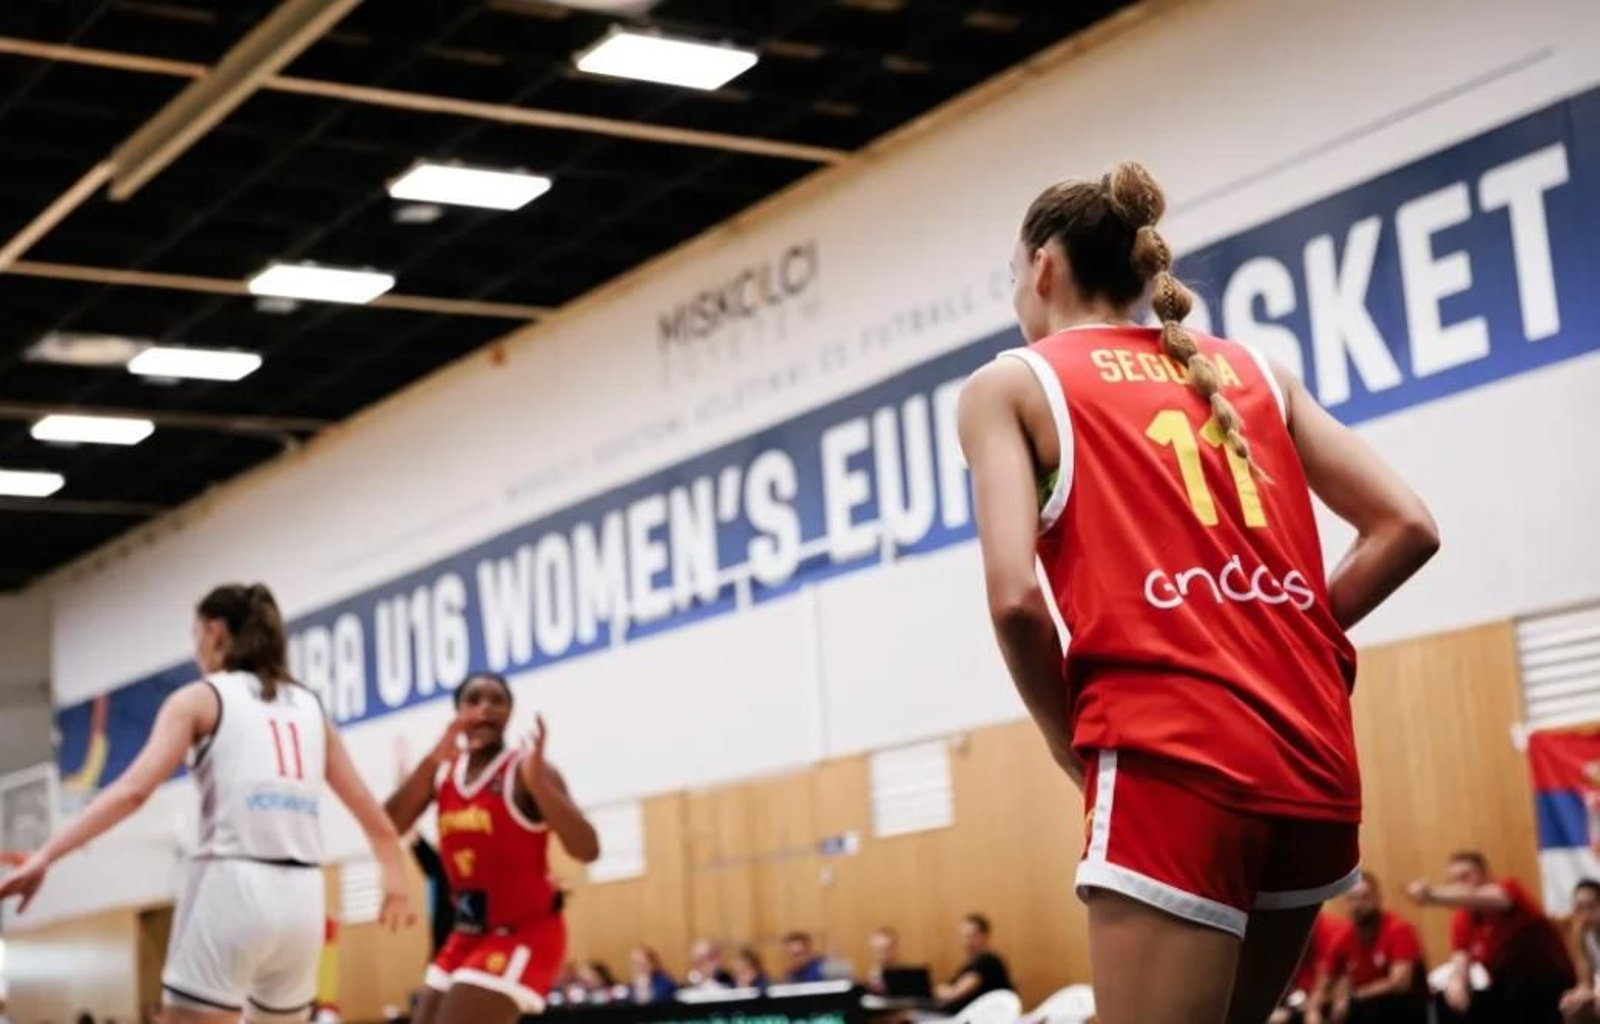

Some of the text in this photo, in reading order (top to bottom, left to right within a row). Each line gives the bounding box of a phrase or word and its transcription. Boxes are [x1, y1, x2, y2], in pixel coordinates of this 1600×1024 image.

[1089, 348, 1242, 388] SEGUA
[1145, 409, 1268, 528] 11
[375, 571, 470, 708] U16
[477, 449, 801, 673] WOMEN'S
[268, 717, 304, 781] 11
